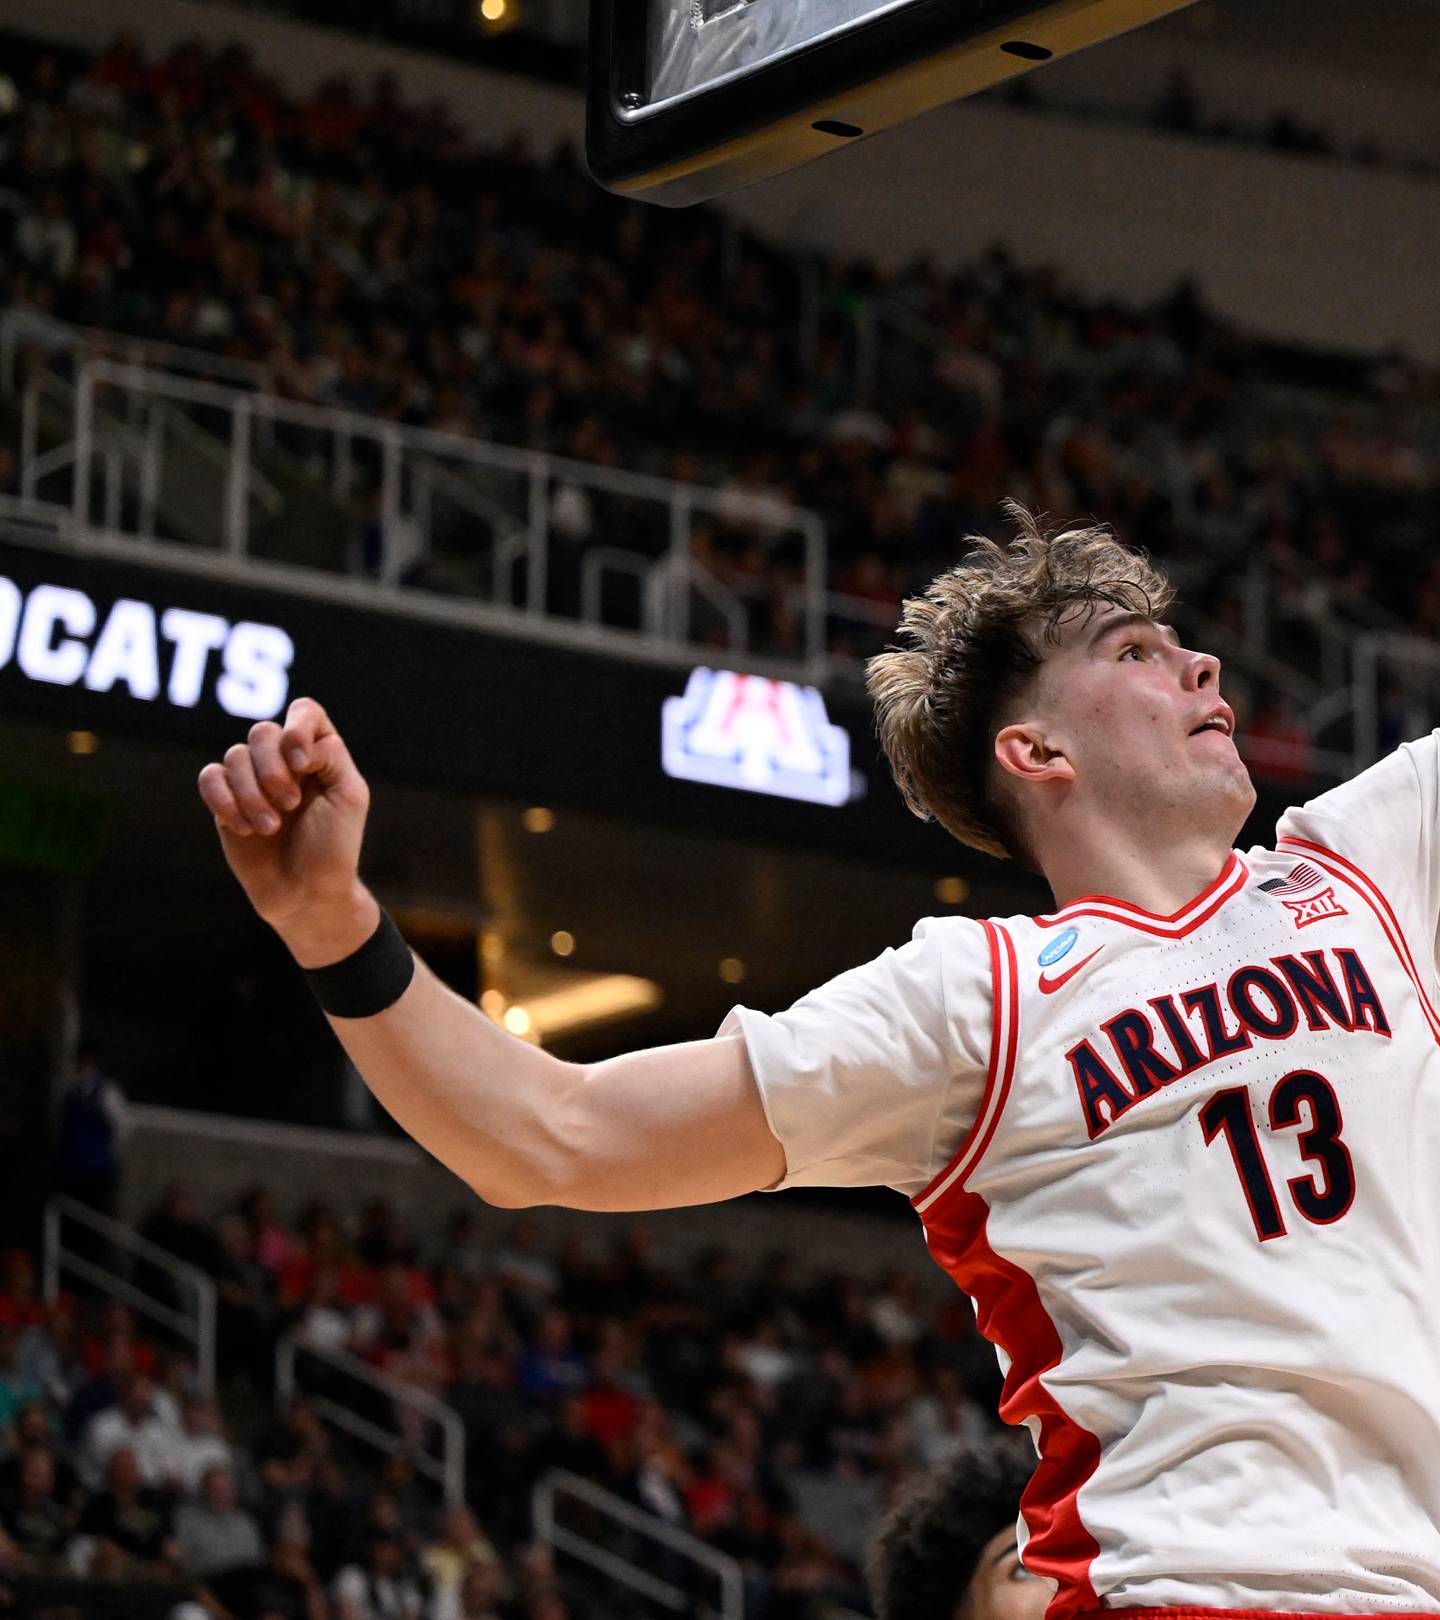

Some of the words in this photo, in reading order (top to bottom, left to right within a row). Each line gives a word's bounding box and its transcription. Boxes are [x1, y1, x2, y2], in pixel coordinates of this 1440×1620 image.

[1282, 888, 1348, 928] XII
[1065, 948, 1392, 1140] ARIZONA
[1198, 1069, 1356, 1242] 13
